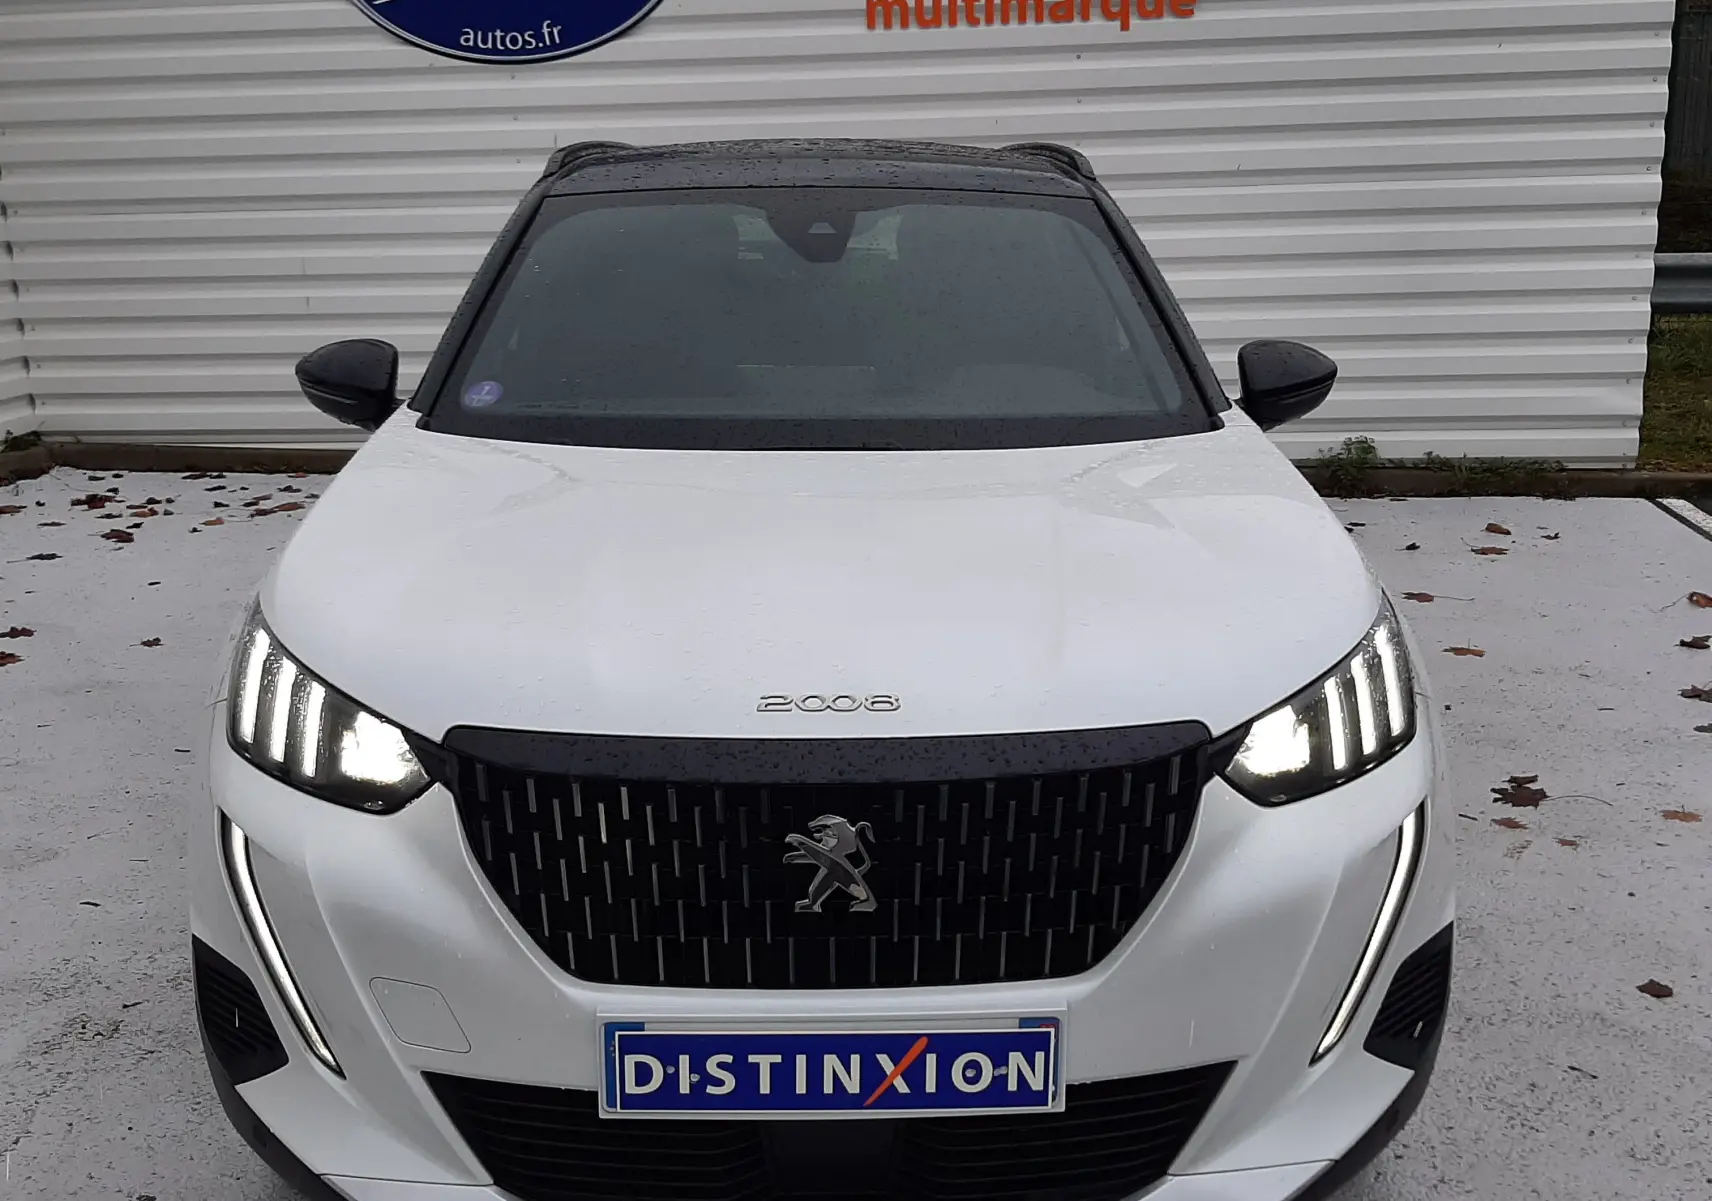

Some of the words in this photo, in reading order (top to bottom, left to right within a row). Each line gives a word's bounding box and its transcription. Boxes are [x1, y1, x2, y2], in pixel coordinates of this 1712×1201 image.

[459, 20, 562, 50] autos.fr
[756, 694, 901, 712] 2008
[623, 1037, 1046, 1106] DISTINXION
